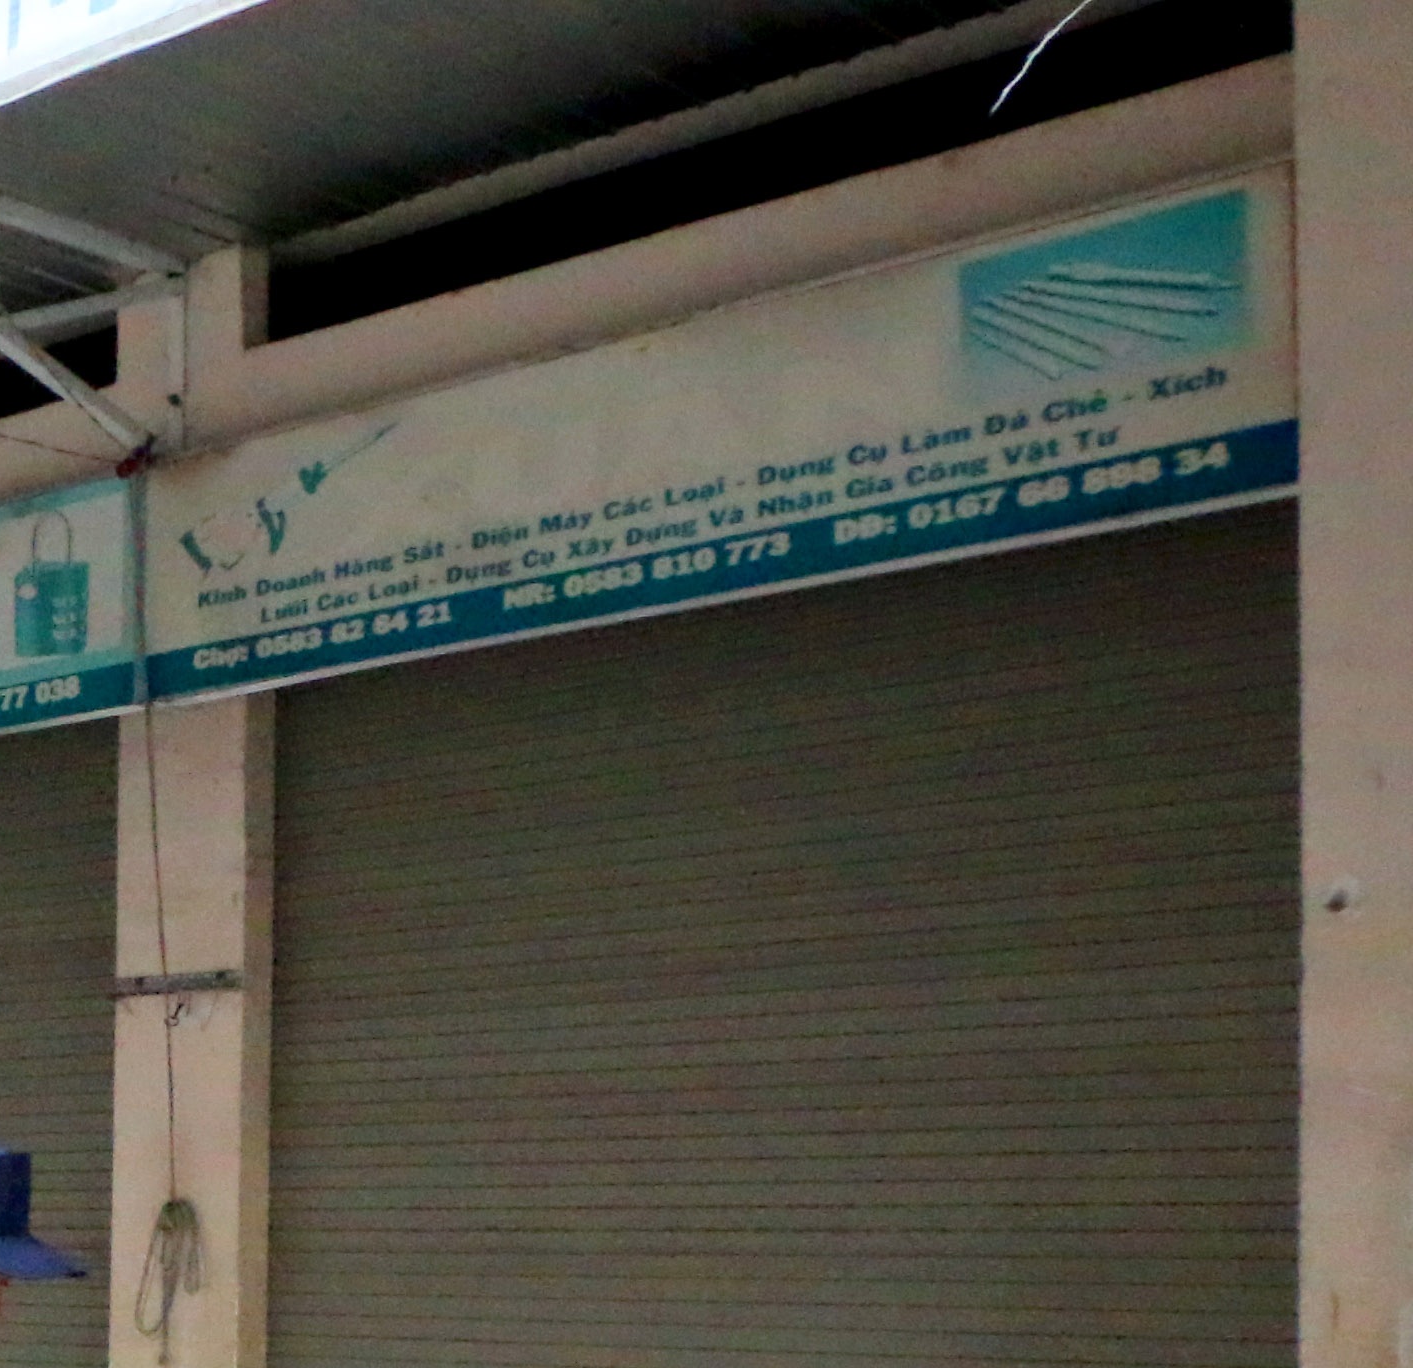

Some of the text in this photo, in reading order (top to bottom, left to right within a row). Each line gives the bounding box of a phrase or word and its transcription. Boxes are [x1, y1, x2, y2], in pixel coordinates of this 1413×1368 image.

[198, 586, 247, 608] Kinh
[256, 569, 325, 596] Doanh
[335, 554, 393, 579] Hàng
[403, 540, 445, 564] Sắt
[539, 510, 593, 535] Máy
[604, 497, 653, 521] Các
[665, 477, 725, 506] Loại
[758, 456, 835, 487] Dụng
[848, 442, 887, 467] Cụ
[902, 425, 971, 454] Làm
[1149, 365, 1228, 400] Xích
[368, 575, 420, 602] Loại
[446, 557, 511, 585] Dụng
[523, 549, 555, 571] Cụ
[568, 536, 615, 560] Xây
[708, 506, 744, 528] Và
[757, 489, 833, 518] Nhận
[845, 476, 893, 501] Gia
[905, 456, 989, 488] Công
[1004, 438, 1060, 467] Vật
[1076, 424, 1121, 450] Tư
[416, 601, 453, 628] 21
[725, 532, 792, 568] 773
